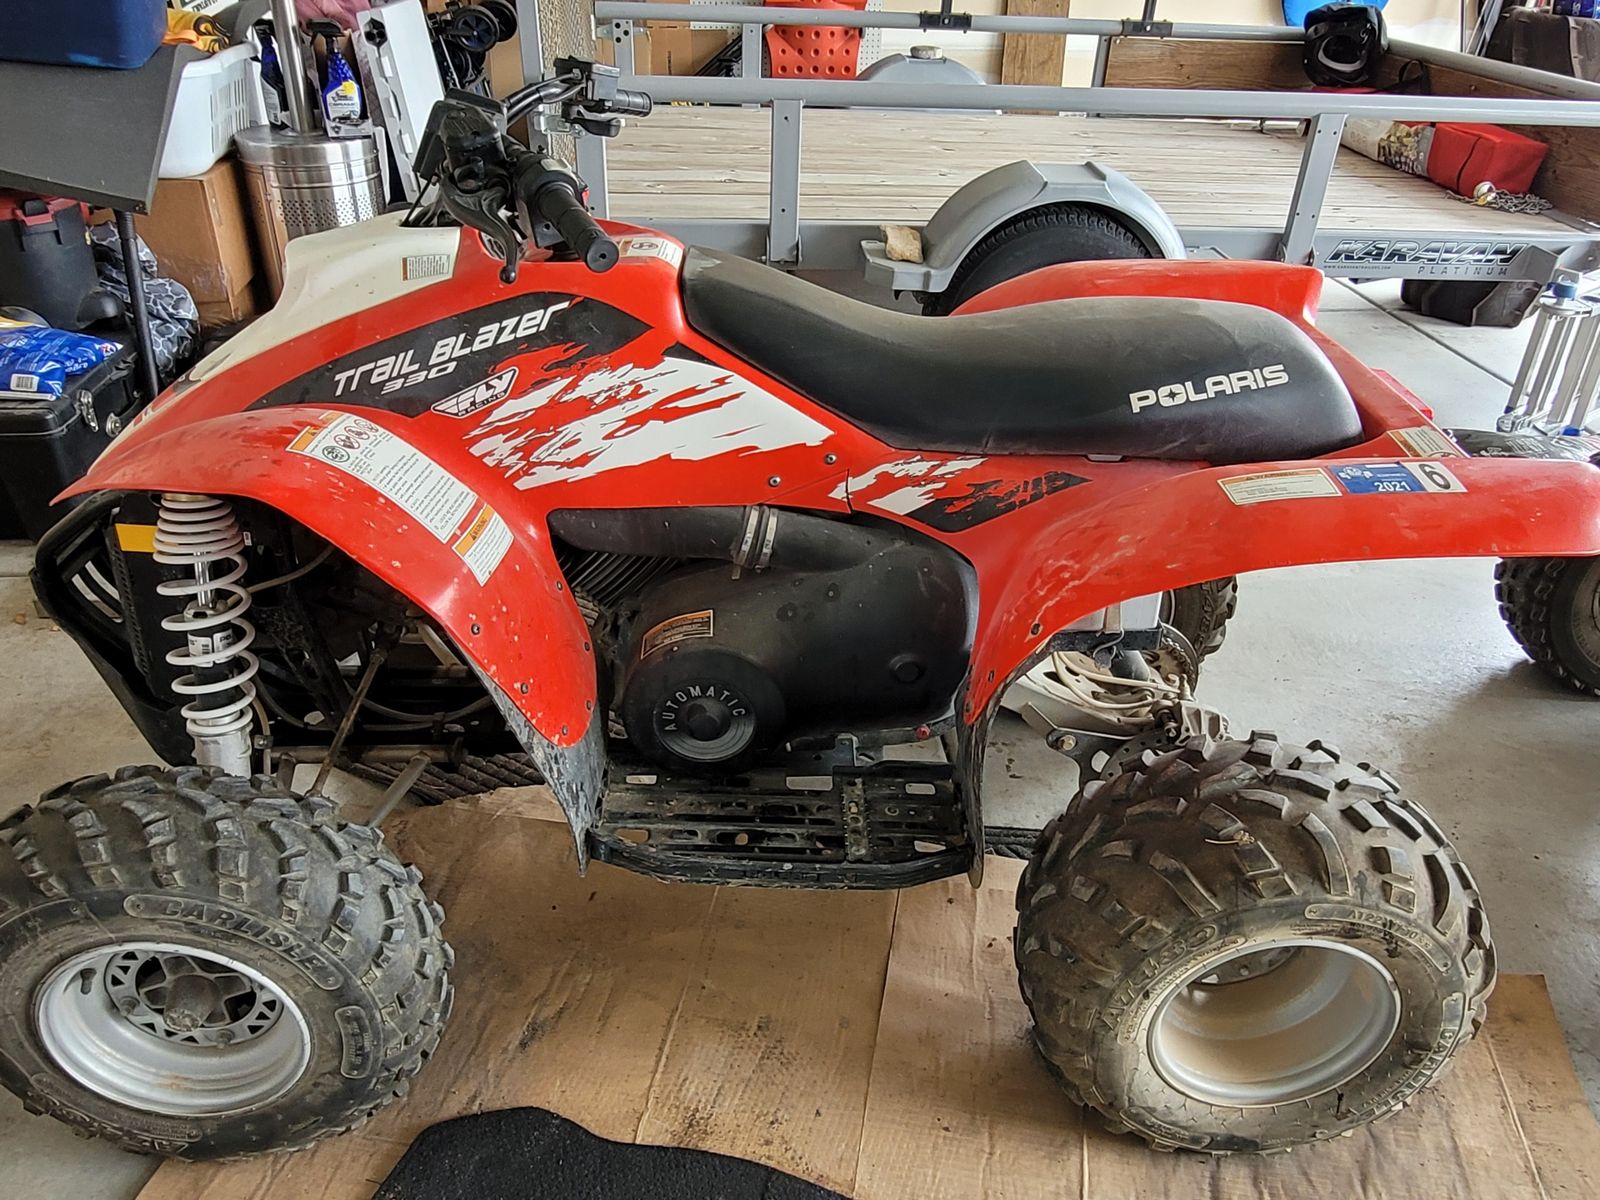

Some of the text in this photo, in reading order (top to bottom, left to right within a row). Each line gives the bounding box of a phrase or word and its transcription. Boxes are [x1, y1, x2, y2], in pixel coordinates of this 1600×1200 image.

[1324, 239, 1529, 265] KARAVAN
[1417, 266, 1508, 275] PLATINUM
[381, 361, 458, 395] 330
[440, 369, 514, 413] FLY
[1128, 364, 1289, 413] POLARIS
[457, 391, 506, 416] RACING
[1374, 481, 1411, 492] 2021
[1418, 463, 1451, 490] 6
[662, 685, 746, 731] AUTOMATIC
[161, 899, 329, 972] CARLISLE
